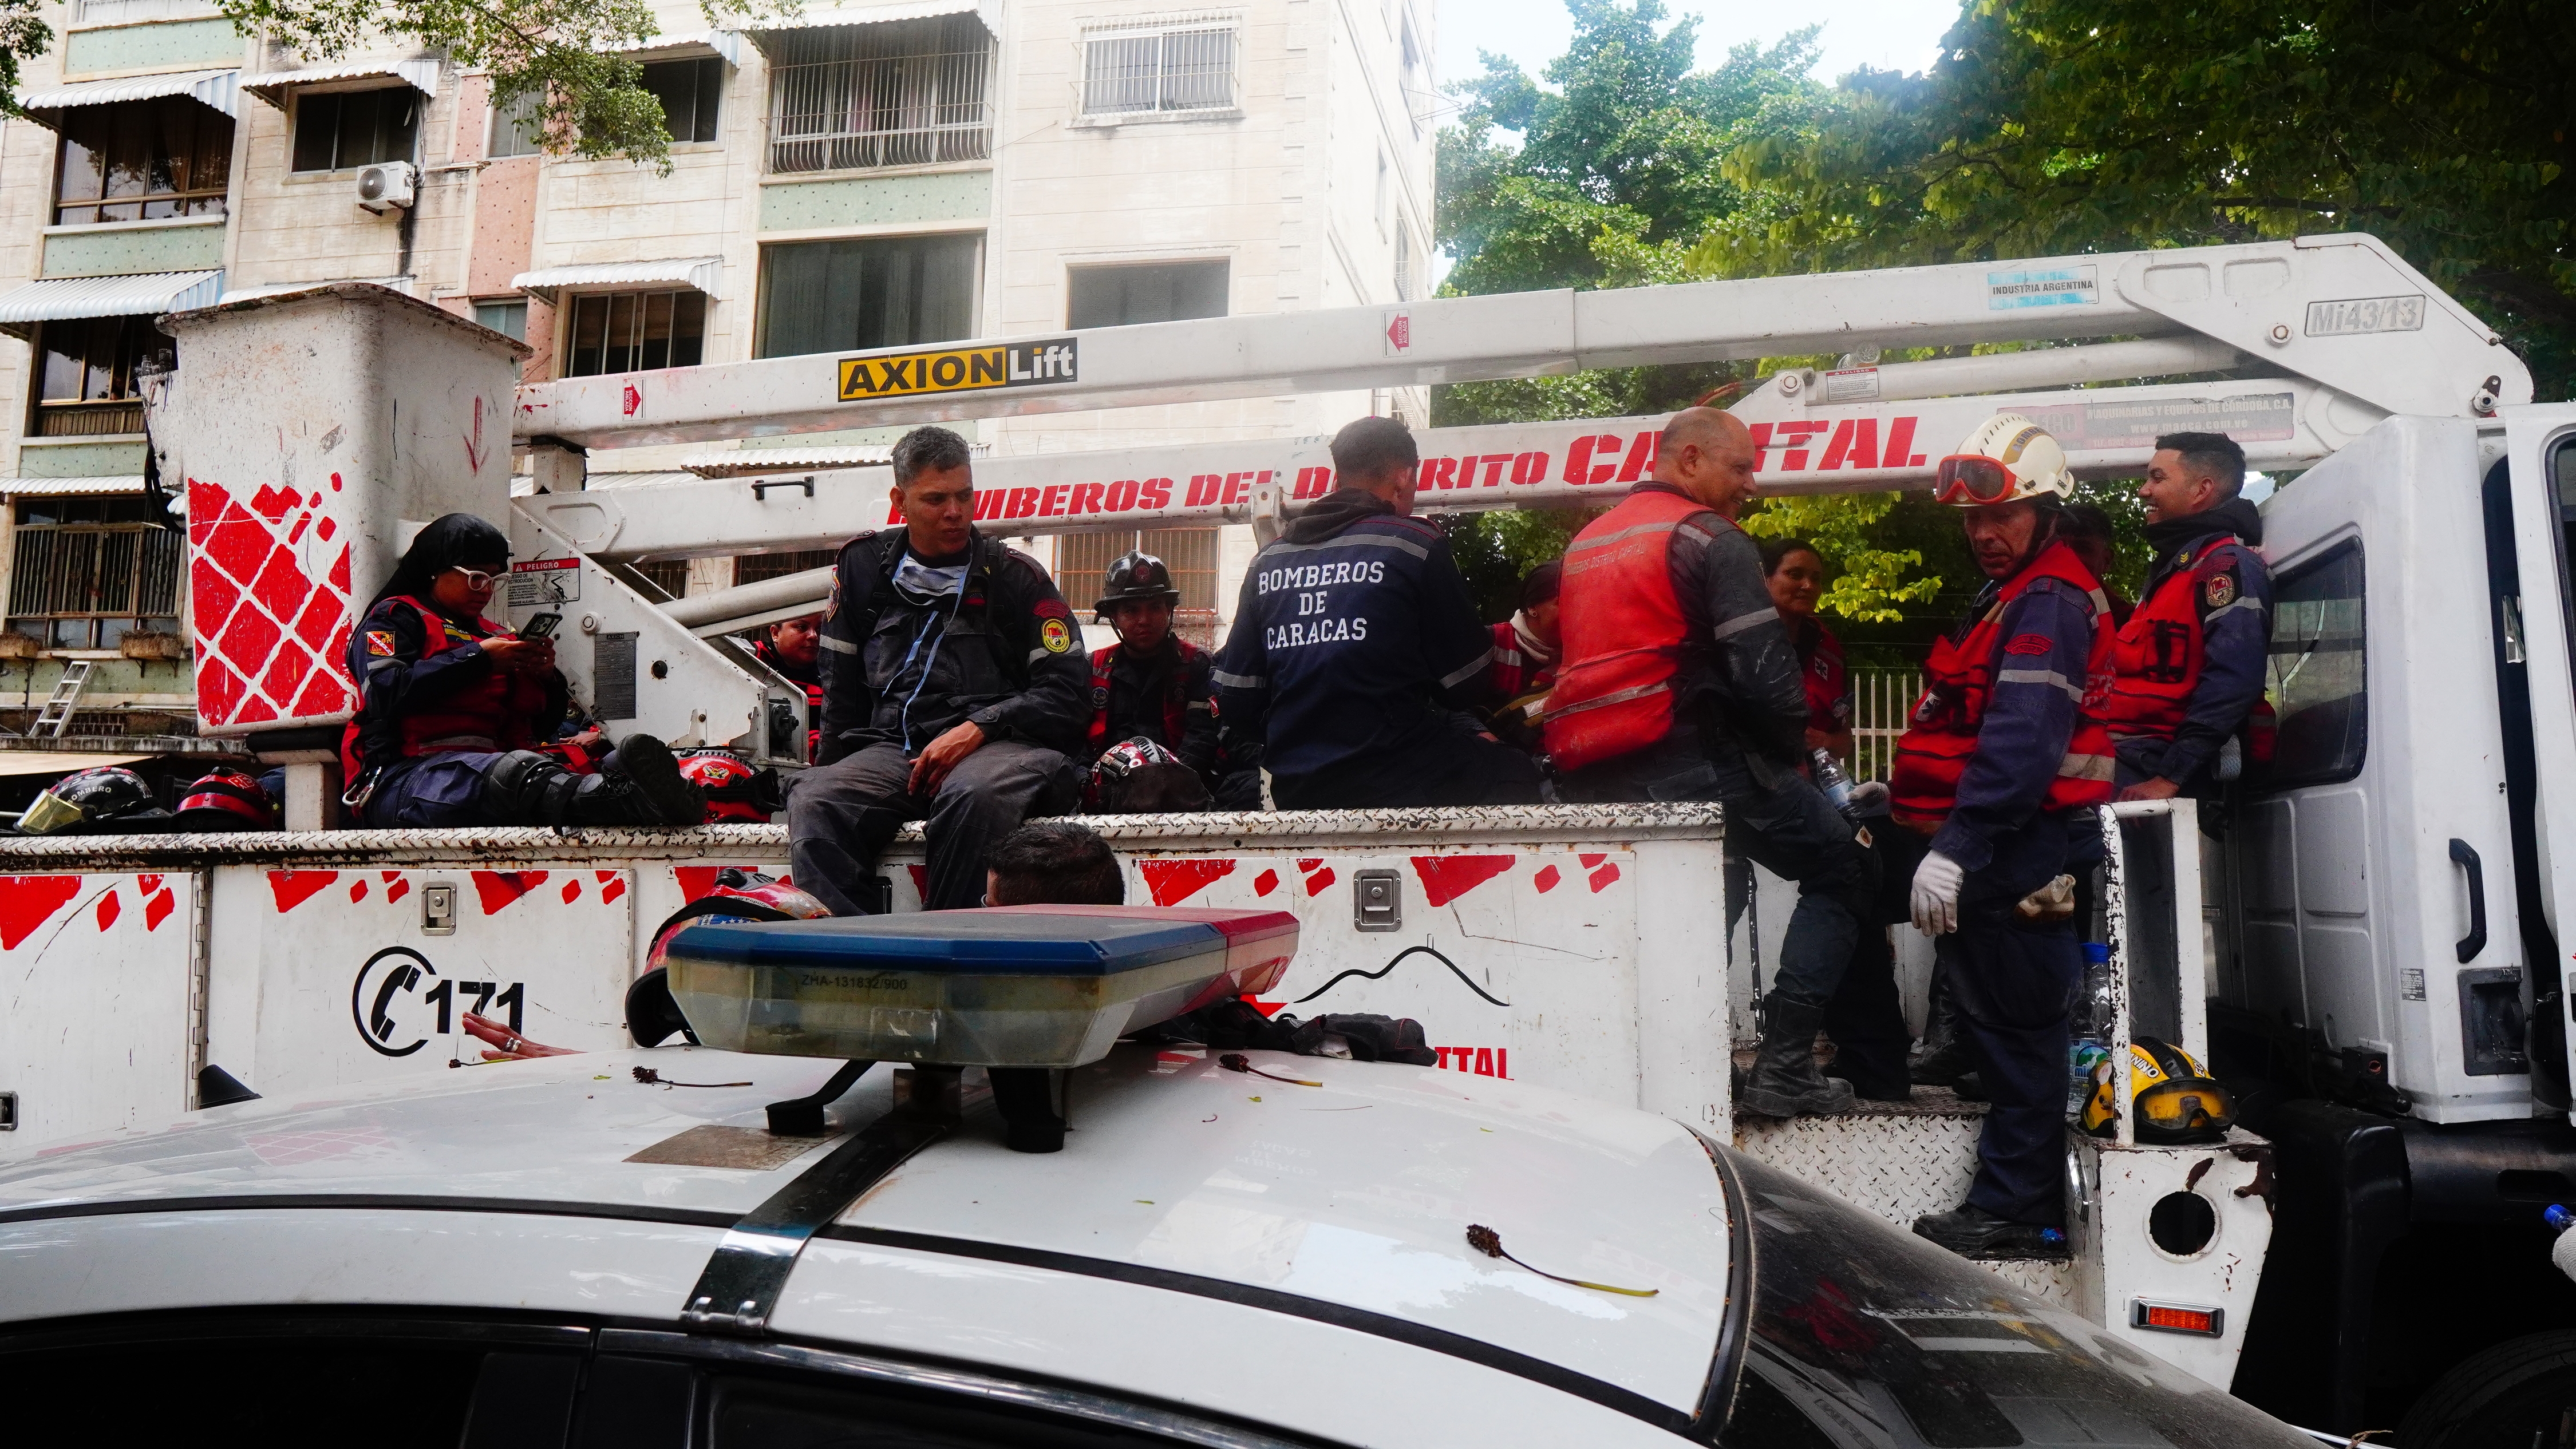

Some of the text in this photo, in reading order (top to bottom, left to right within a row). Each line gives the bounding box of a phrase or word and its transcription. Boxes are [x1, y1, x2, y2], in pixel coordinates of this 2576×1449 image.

[1993, 280, 2093, 295] INDUSTRIA ARGENTINA
[2087, 406, 2154, 419] MAQUINARIAS
[2156, 406, 2162, 415] Y
[2164, 402, 2204, 417] EQUIPOS
[2208, 402, 2221, 413] DE
[2273, 399, 2292, 409] C.A.
[887, 477, 1174, 525] MBEROS
[527, 561, 559, 570] PELIGRO
[1259, 561, 1385, 595] BOMBEROS
[1299, 591, 1327, 616] DE
[1267, 617, 1367, 650] CARACAS
[425, 979, 524, 1036] 171
